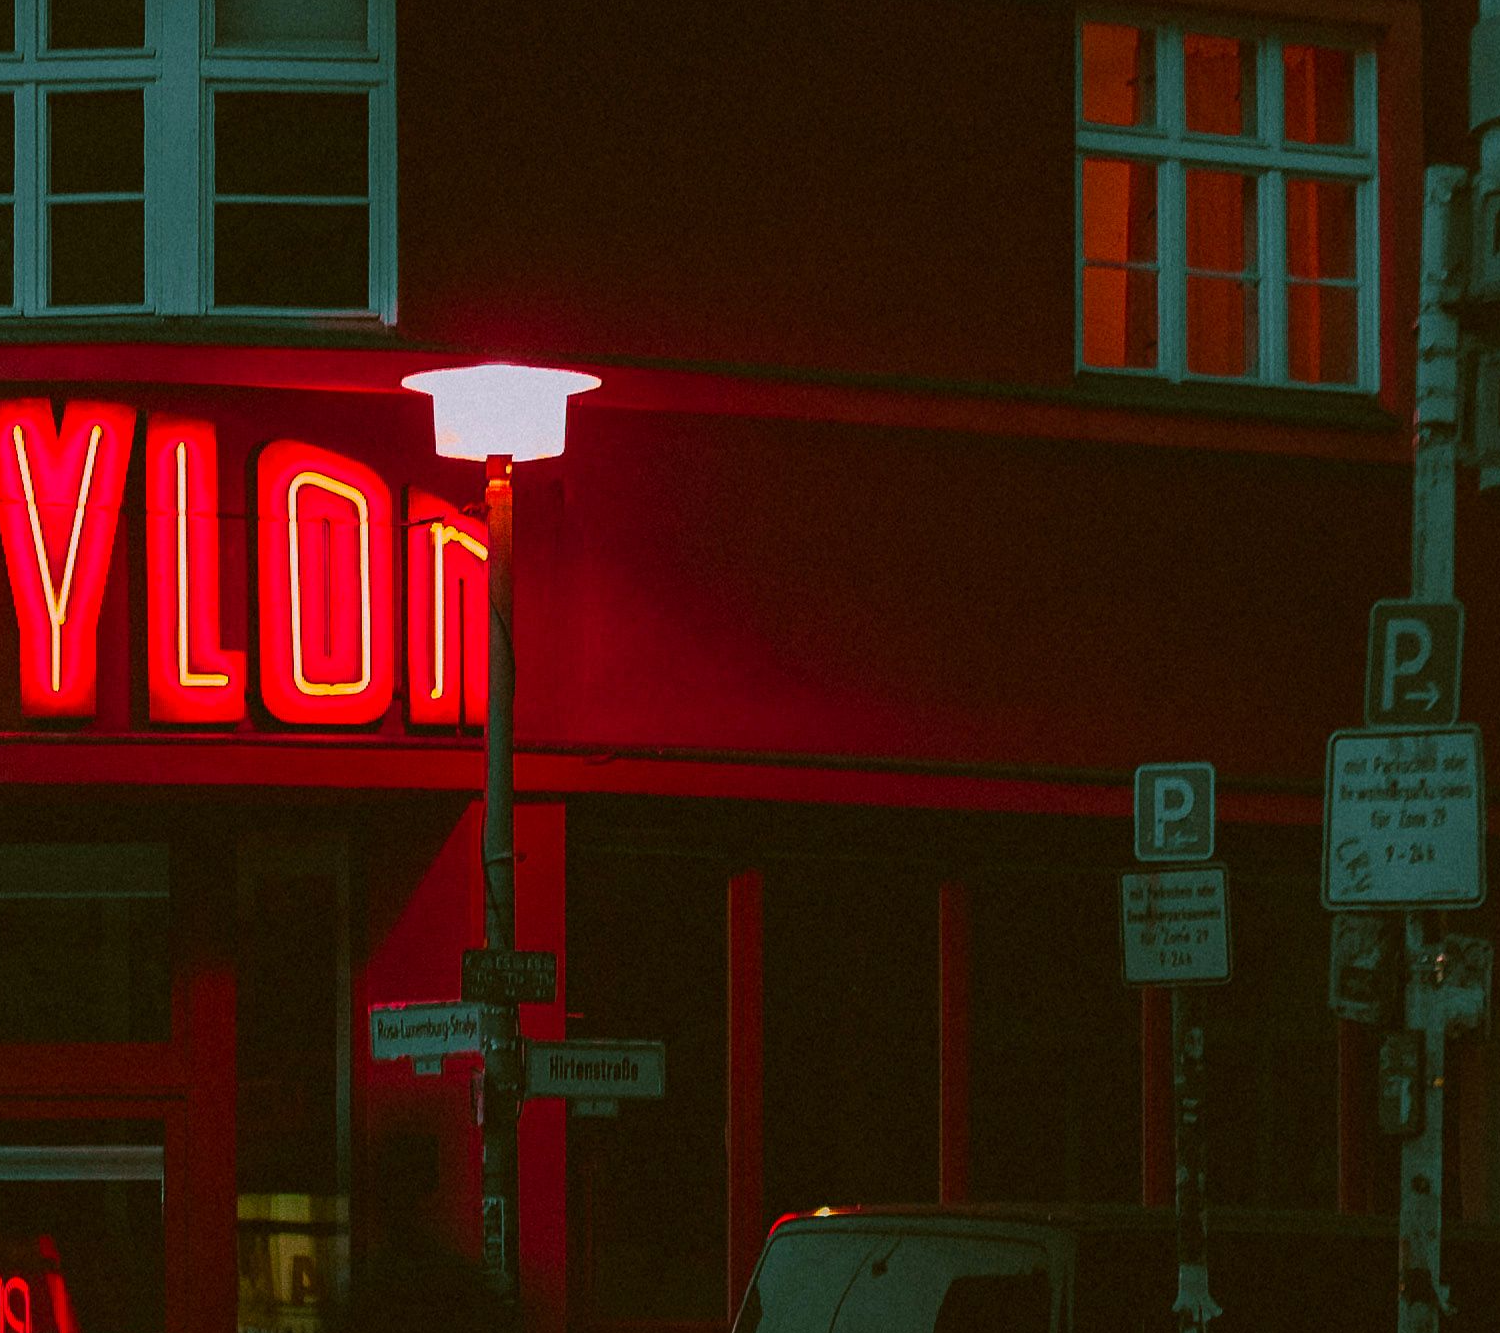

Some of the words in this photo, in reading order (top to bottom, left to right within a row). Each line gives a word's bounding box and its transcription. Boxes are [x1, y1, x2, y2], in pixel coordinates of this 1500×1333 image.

[1380, 617, 1433, 712] P
[1153, 776, 1196, 849] P
[549, 1054, 639, 1082] Hirtenstraße
